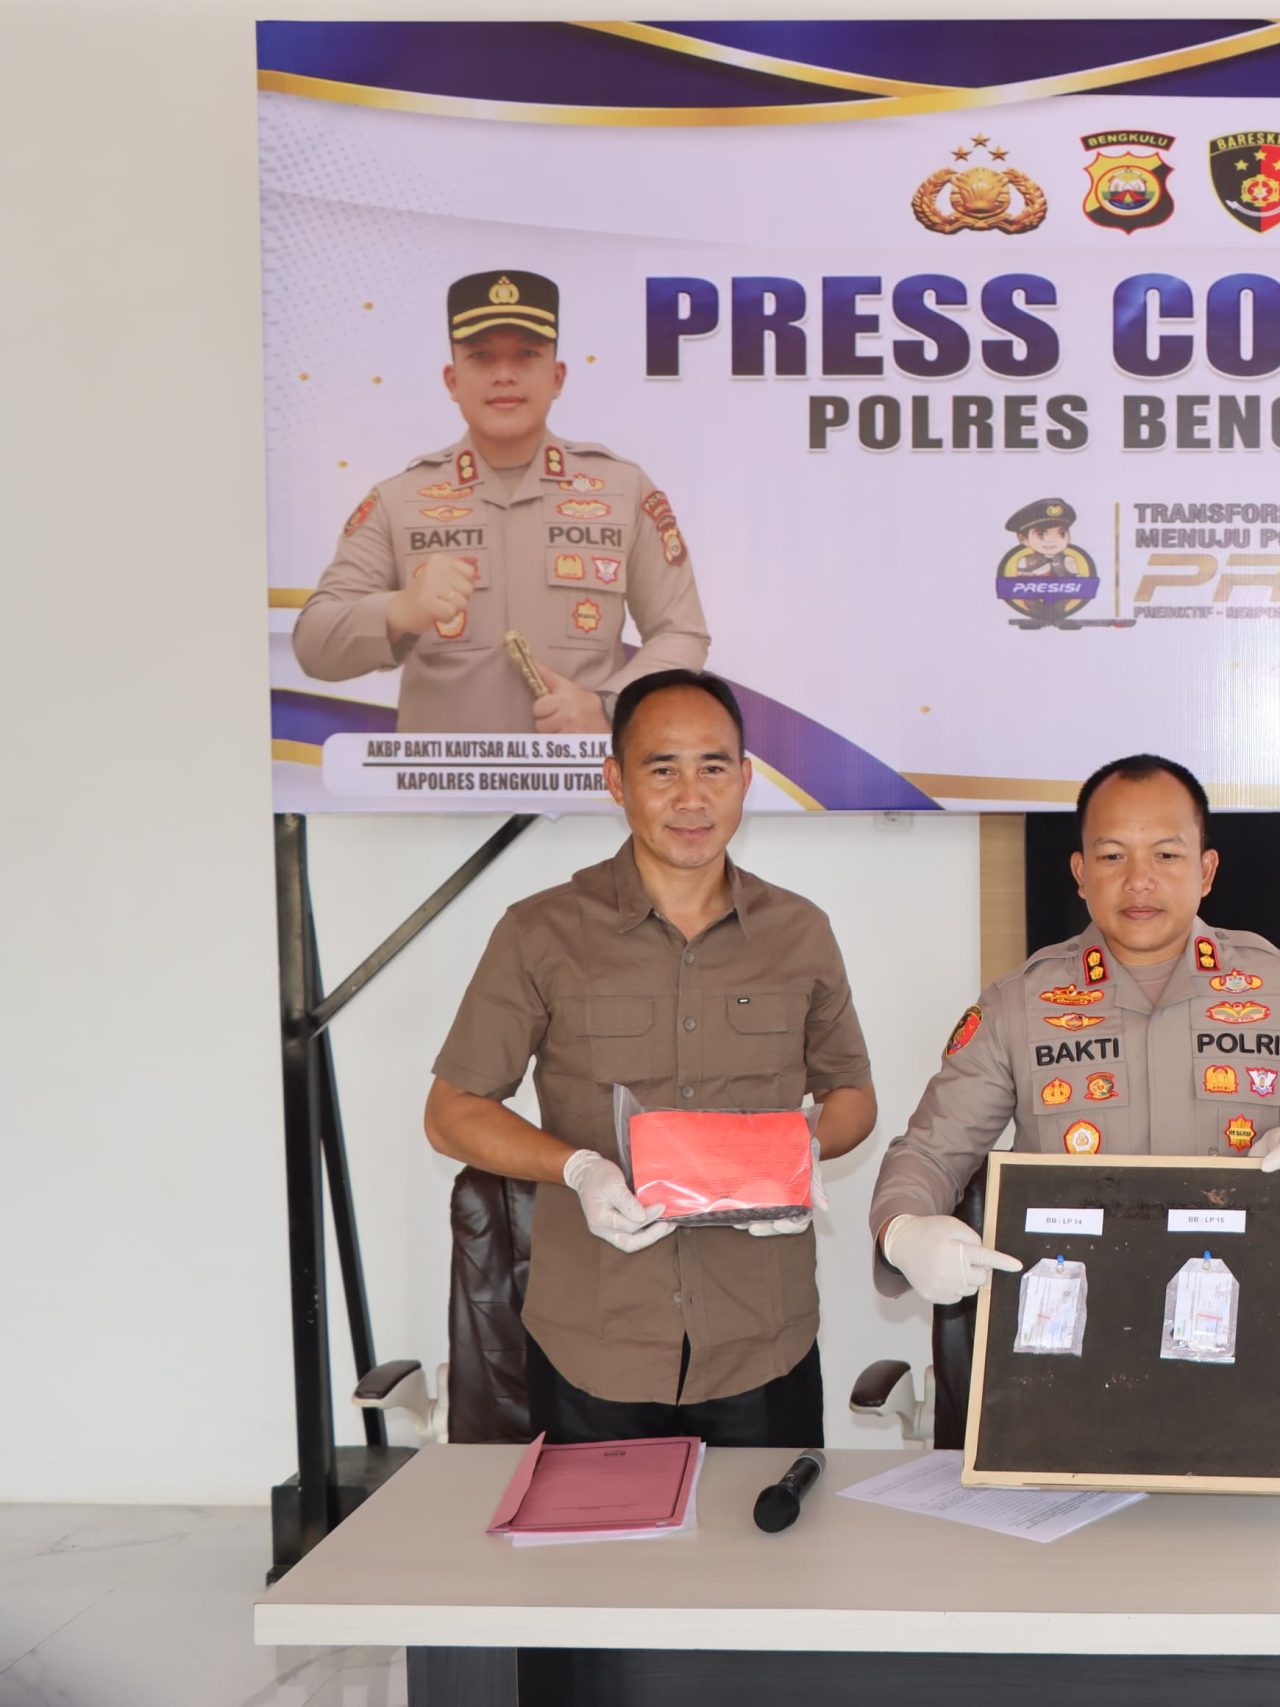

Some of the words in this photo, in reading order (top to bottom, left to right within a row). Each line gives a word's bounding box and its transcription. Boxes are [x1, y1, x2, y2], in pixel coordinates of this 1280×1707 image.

[1088, 133, 1168, 147] BENGKULU
[645, 275, 1060, 379] PRESS
[809, 395, 1087, 450] POLRES
[410, 528, 483, 550] BAKTI
[549, 526, 623, 547] POLRI
[1135, 528, 1251, 549] MENUJU
[1012, 582, 1082, 593] PRESISI
[367, 740, 401, 758] AKBP
[404, 740, 442, 758] BAKTI
[445, 740, 504, 758] KAUTSAR
[507, 740, 529, 760] ALI,
[532, 740, 543, 758] S.
[397, 772, 475, 791] KAPOLRES
[479, 772, 559, 791] BENGKULU
[1035, 1037, 1119, 1067] BAKTI
[1197, 1033, 1280, 1056] POLRI
